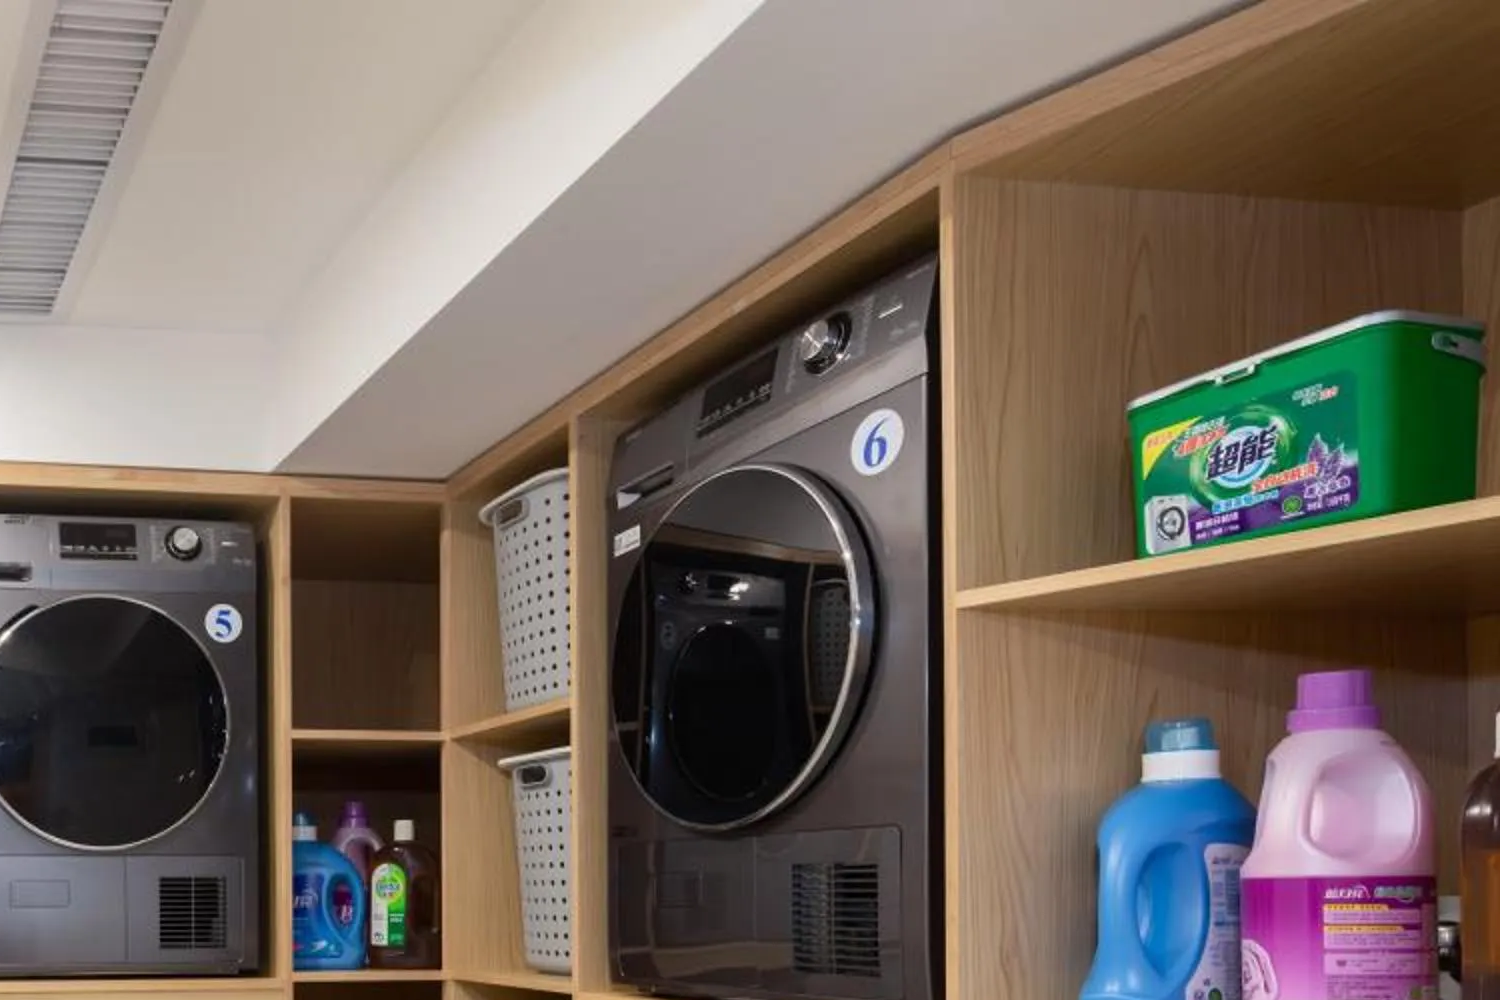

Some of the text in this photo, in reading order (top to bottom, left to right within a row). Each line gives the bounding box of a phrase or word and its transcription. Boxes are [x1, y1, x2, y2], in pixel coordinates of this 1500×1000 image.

[863, 416, 892, 467] 6
[1206, 424, 1277, 480] 超能
[214, 609, 233, 638] 5
